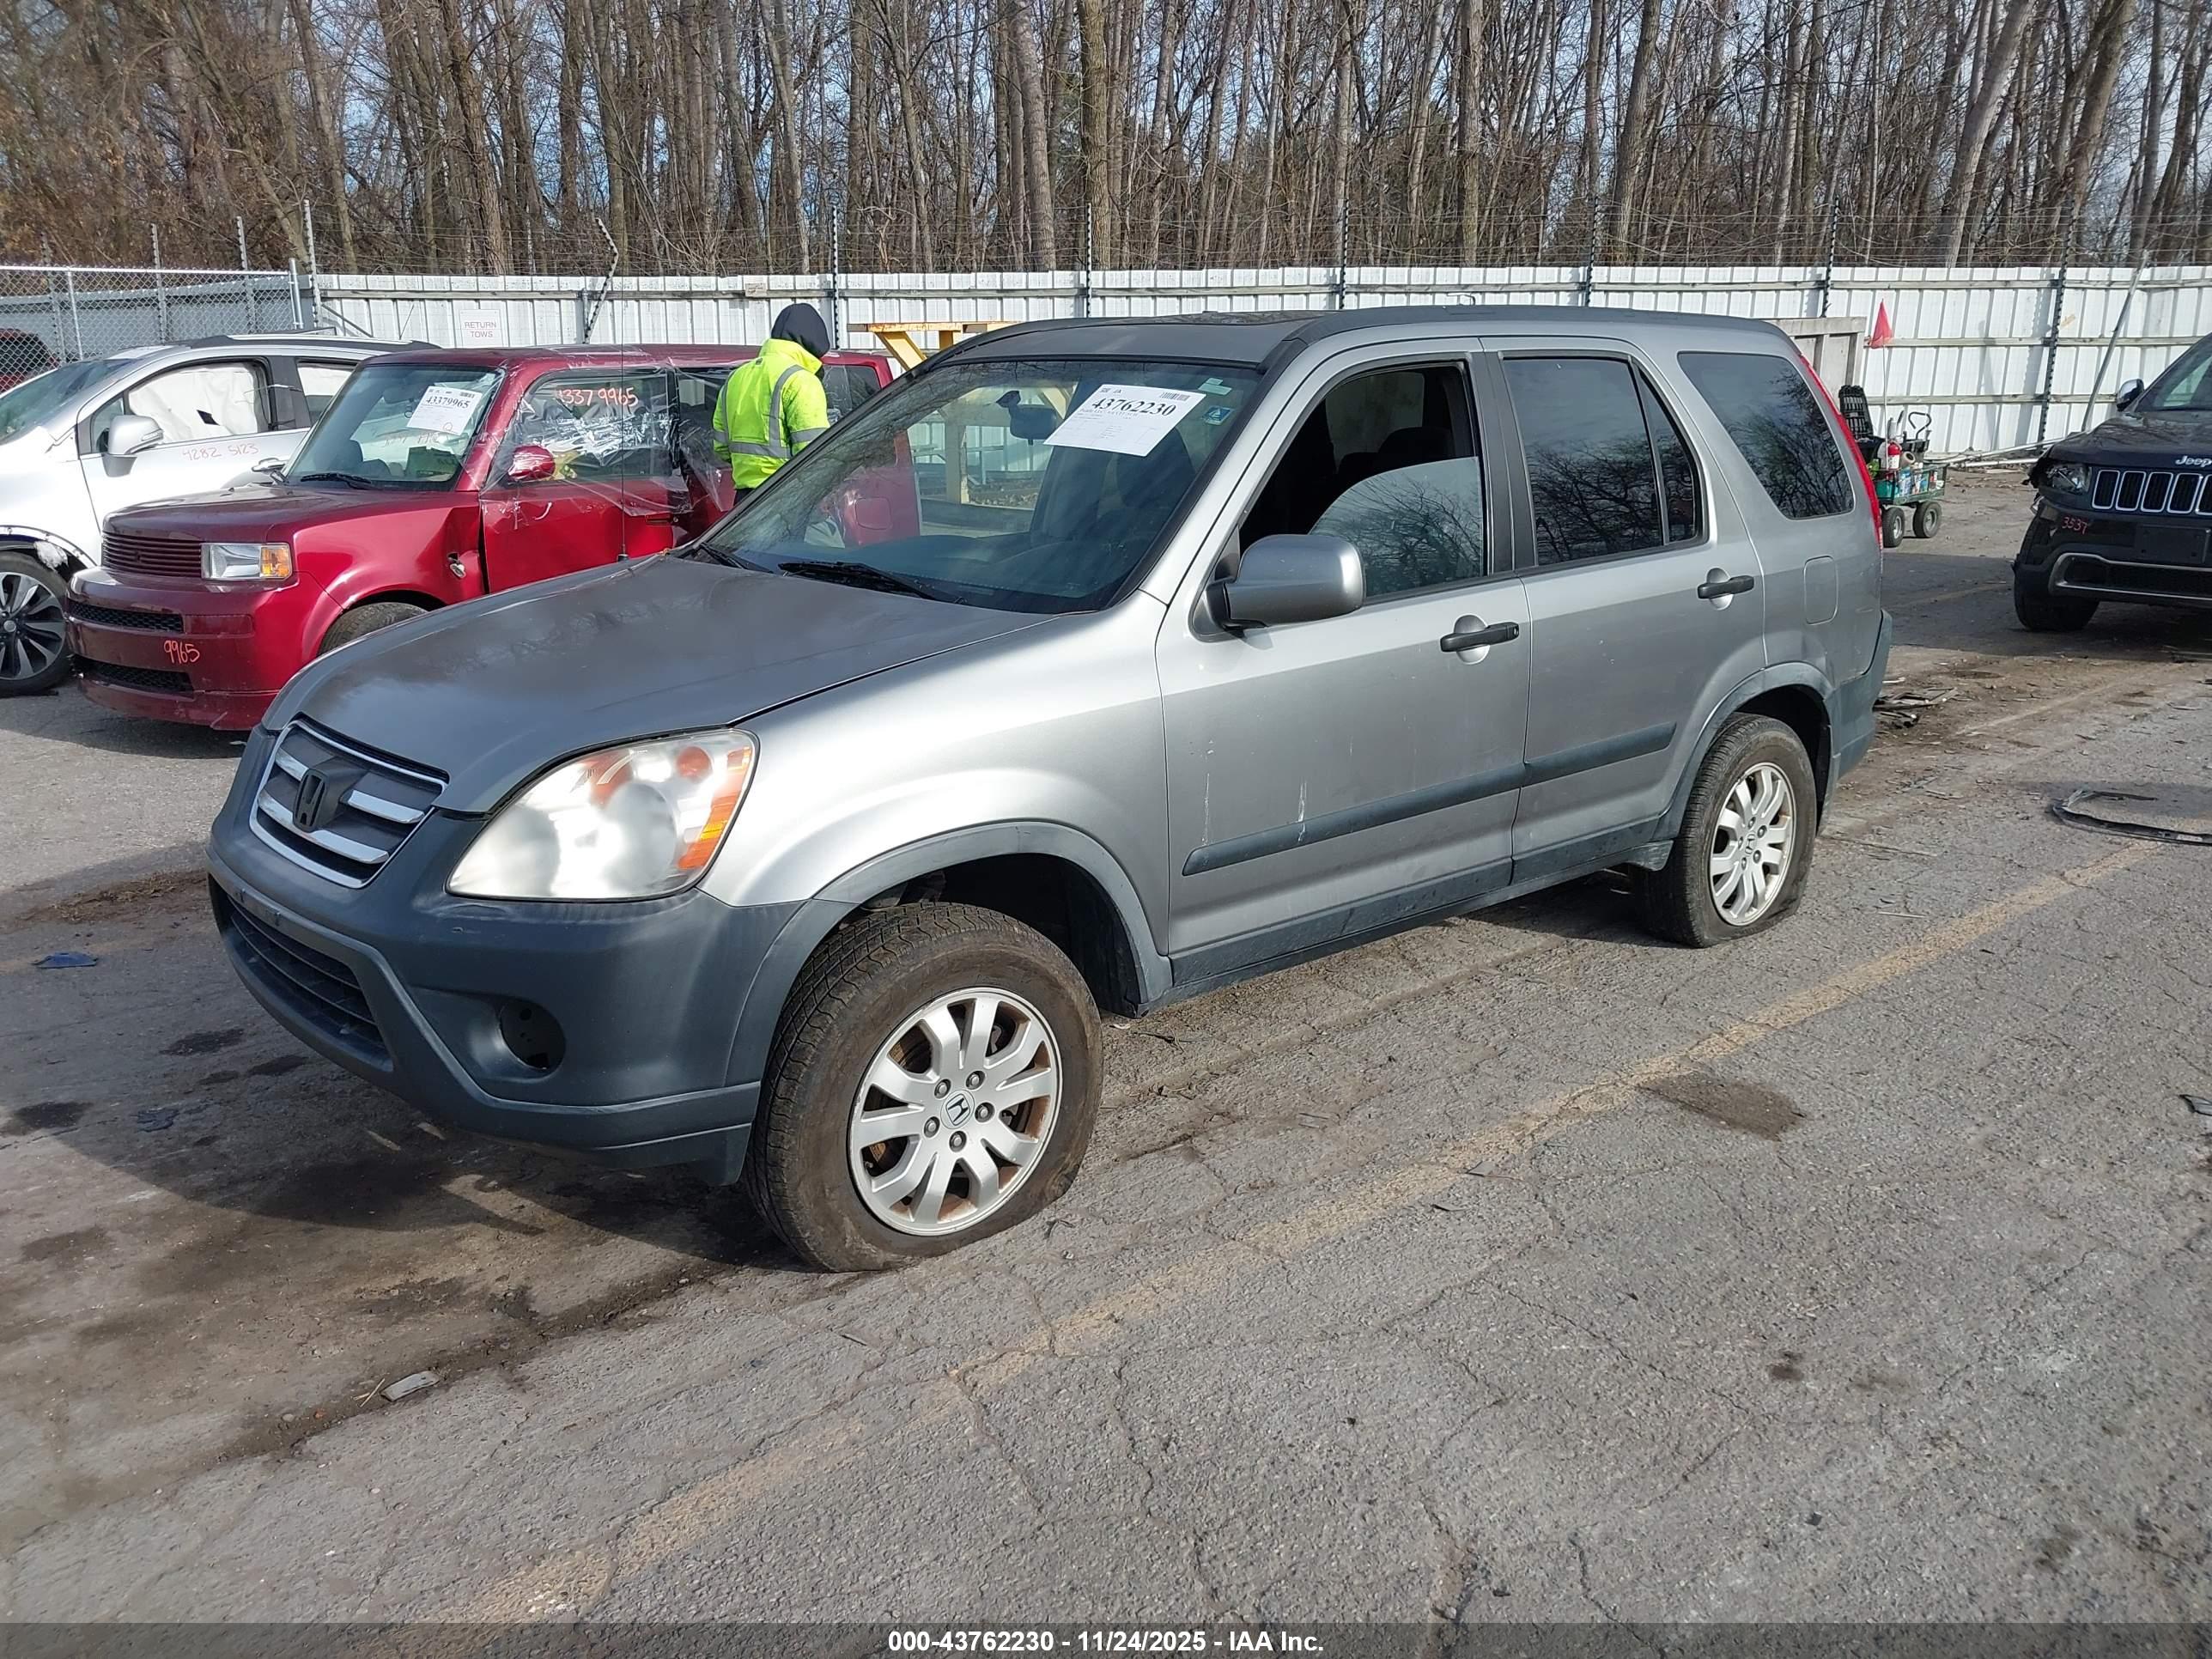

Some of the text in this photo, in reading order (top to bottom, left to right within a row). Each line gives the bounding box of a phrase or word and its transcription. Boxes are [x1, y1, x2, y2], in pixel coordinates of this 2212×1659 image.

[426, 395, 471, 409] 43379965
[597, 386, 639, 407] 9965
[1091, 398, 1177, 416] 43762230
[2175, 455, 2212, 468] Jeep
[2062, 516, 2088, 535] 3537
[163, 640, 200, 664] 9965
